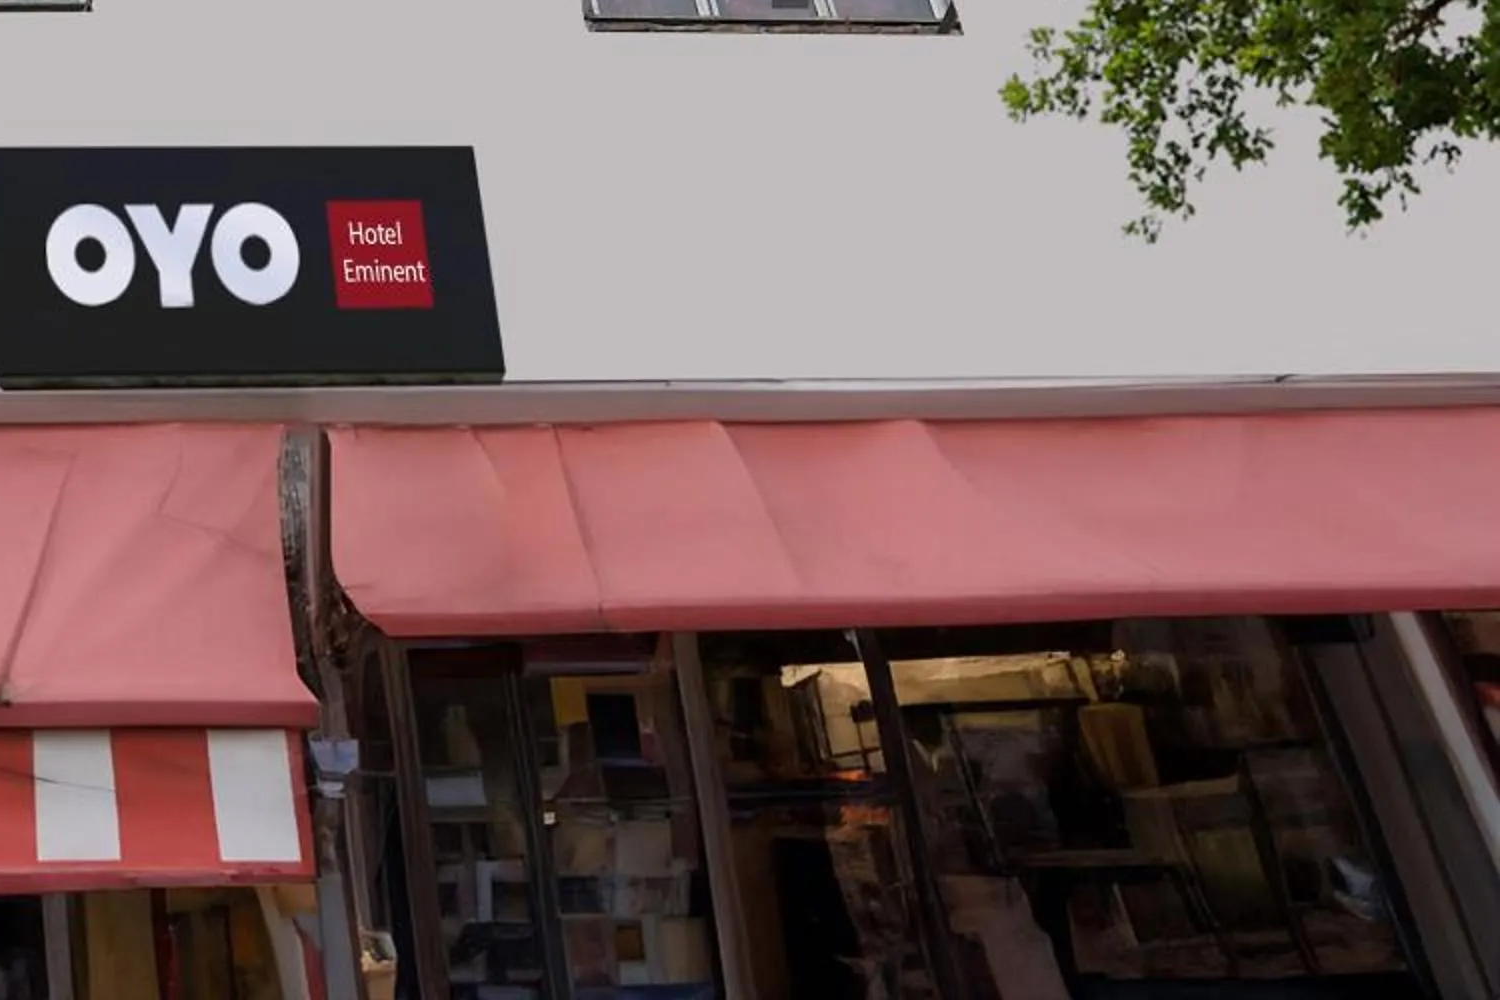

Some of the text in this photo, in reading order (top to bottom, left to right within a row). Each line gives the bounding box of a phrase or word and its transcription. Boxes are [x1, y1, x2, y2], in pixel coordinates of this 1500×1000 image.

[347, 220, 403, 245] Hotel
[45, 202, 300, 308] OYO
[343, 258, 427, 283] Eminent
